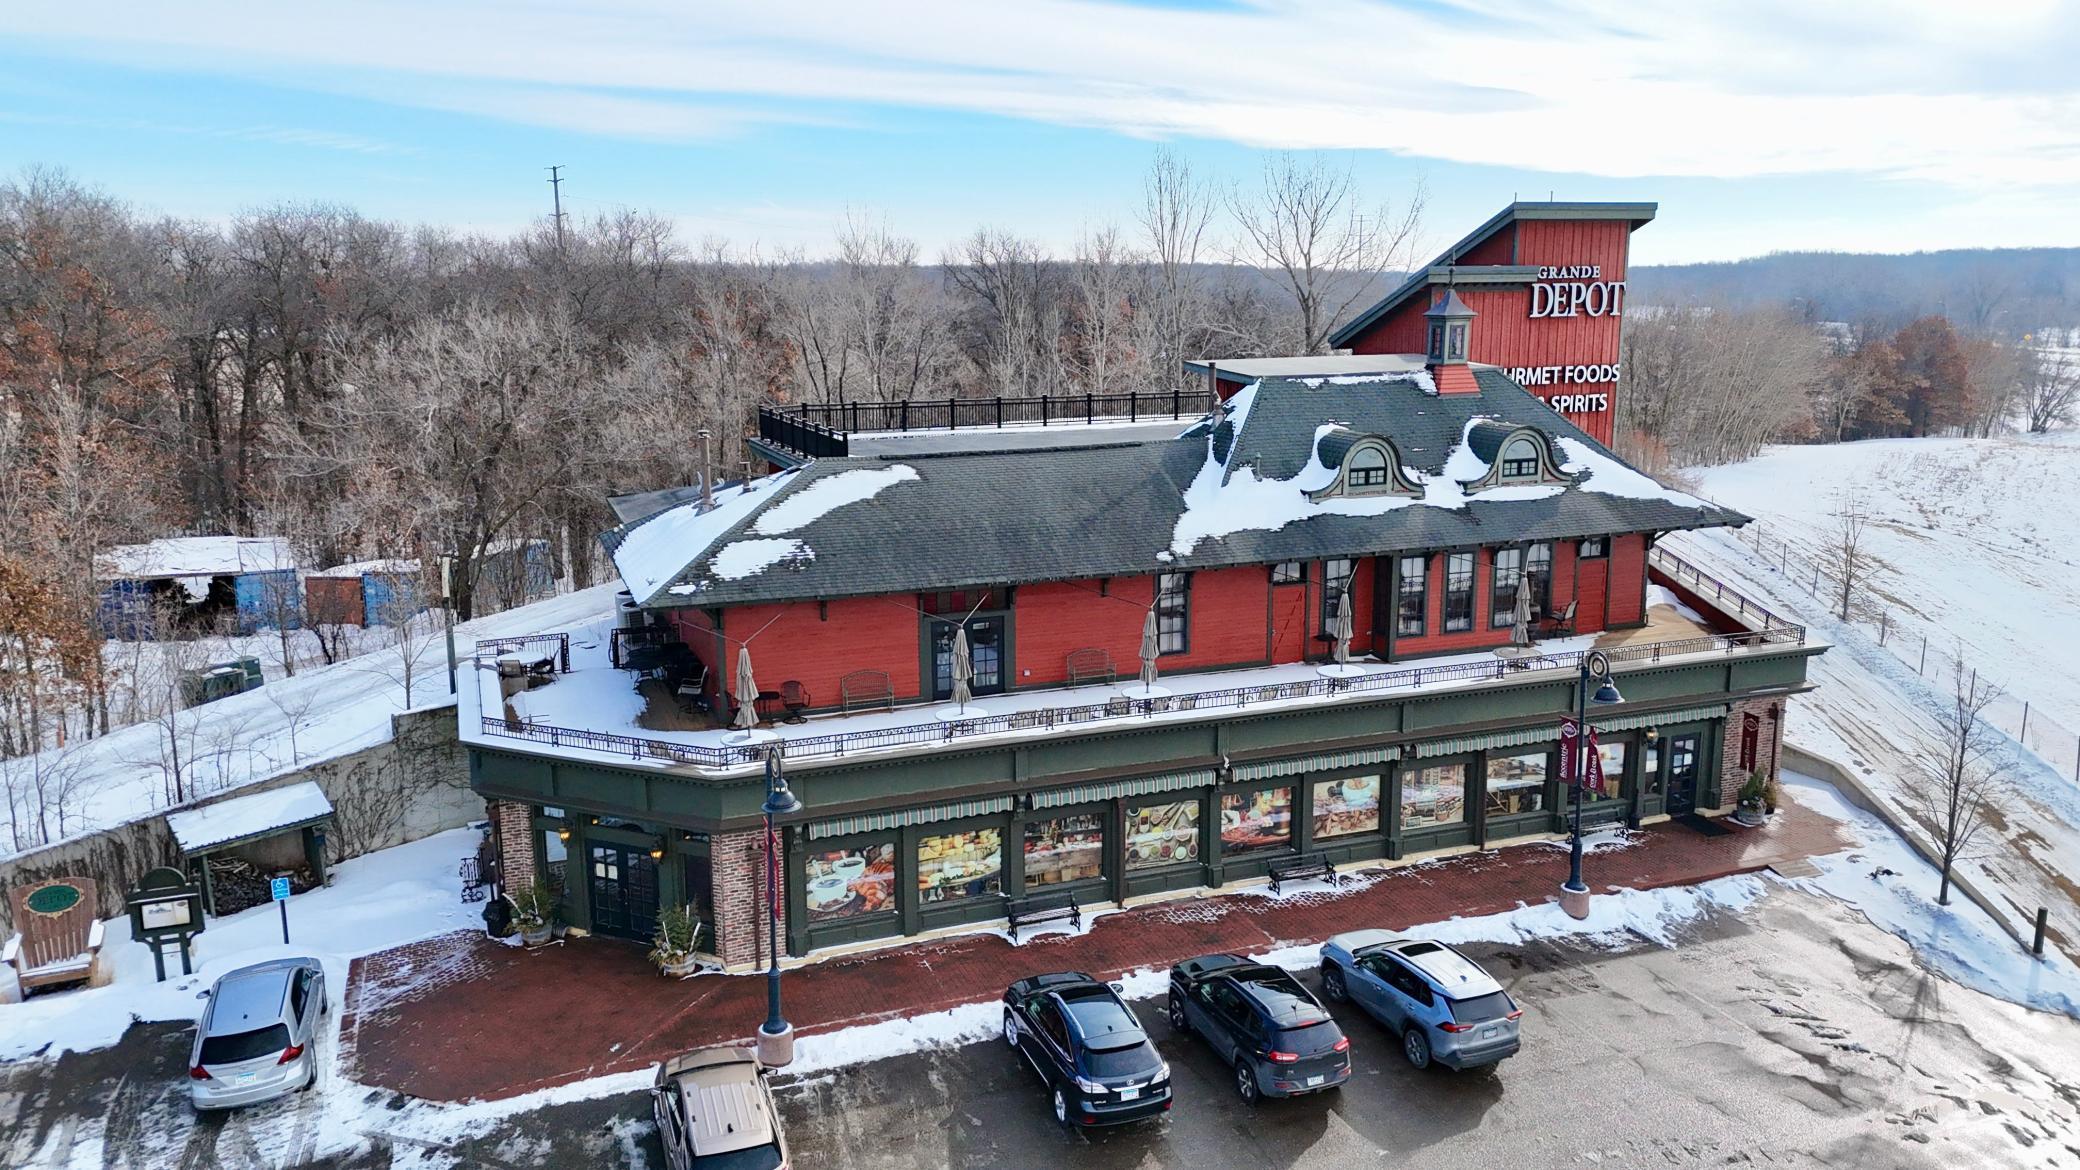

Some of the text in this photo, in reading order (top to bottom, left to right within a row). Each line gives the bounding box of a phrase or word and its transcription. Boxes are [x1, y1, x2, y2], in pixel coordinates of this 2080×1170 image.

[1538, 265, 1600, 279] GRANDE
[1530, 281, 1626, 317] DEPOT
[1564, 364, 1620, 383] FOODS
[1551, 394, 1607, 413] SPIRITS
